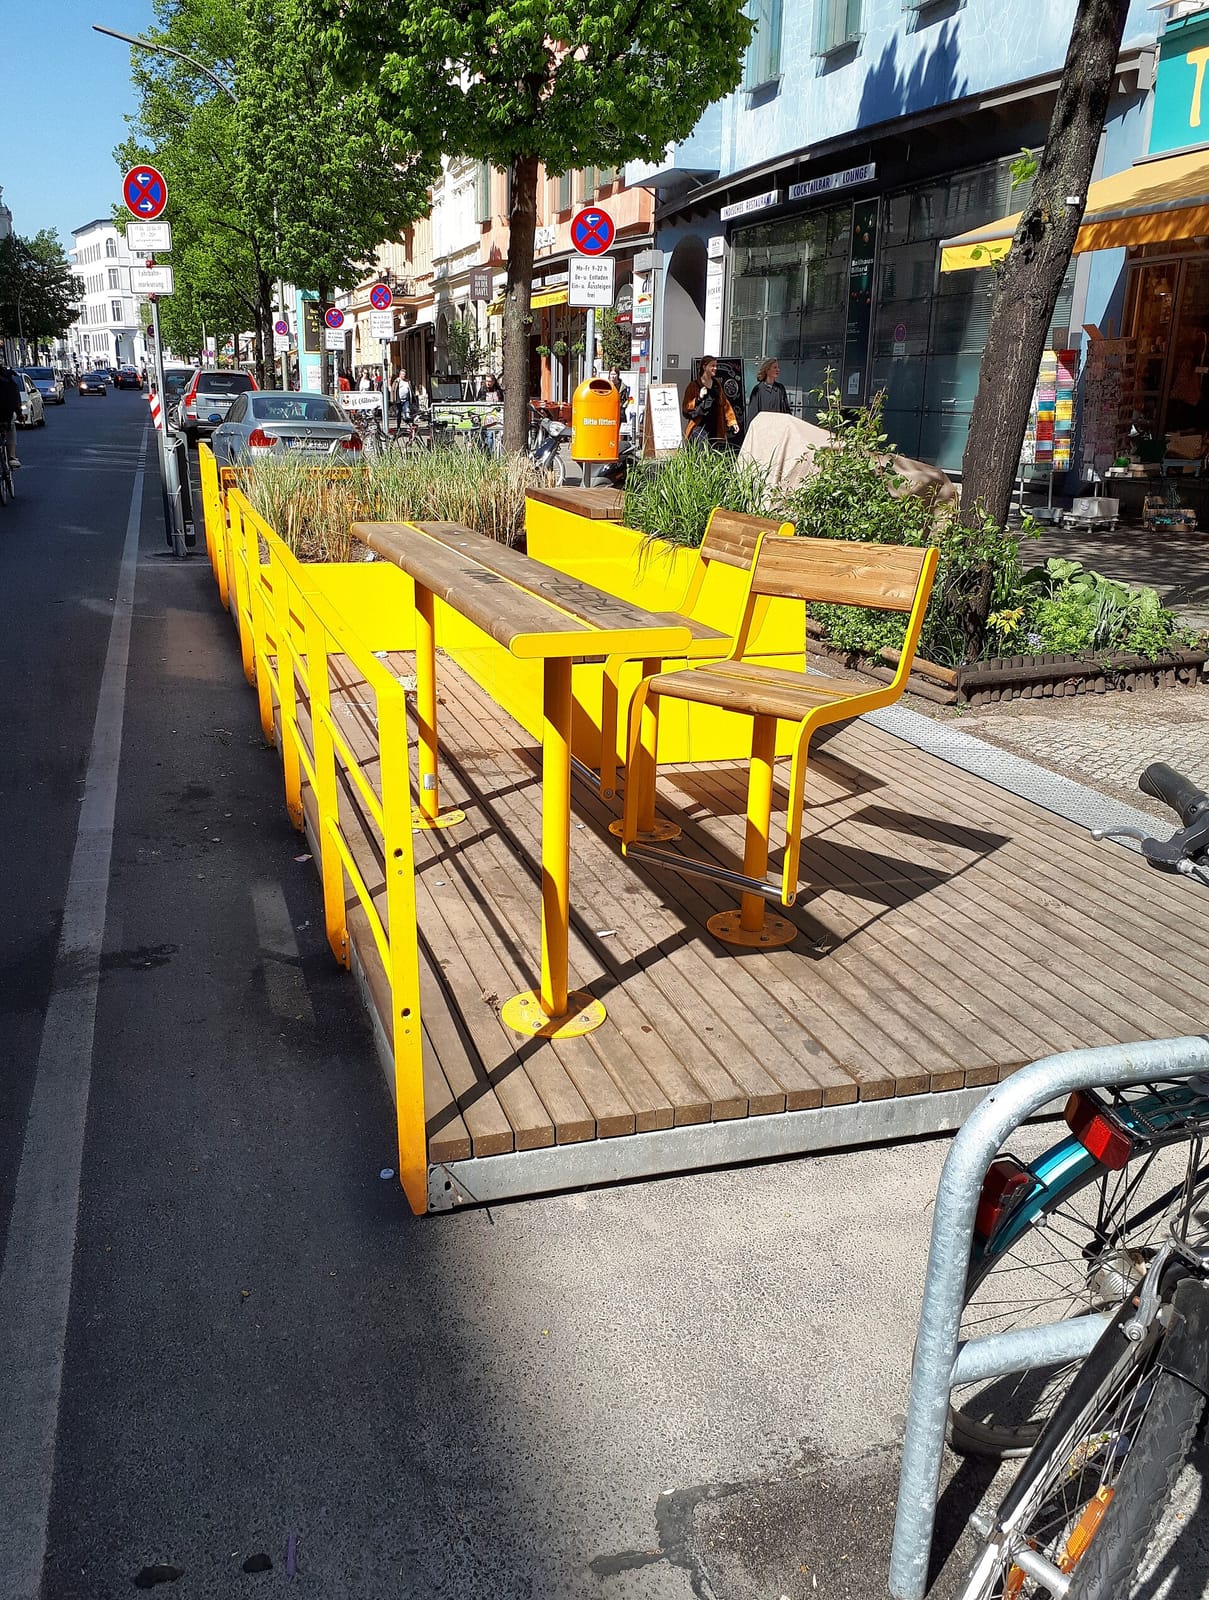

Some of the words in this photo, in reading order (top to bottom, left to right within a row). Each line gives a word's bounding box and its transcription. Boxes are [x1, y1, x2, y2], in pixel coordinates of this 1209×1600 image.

[793, 177, 830, 197] COCKTAILBAR
[842, 166, 868, 183] LOUNGE
[723, 204, 744, 218] INDISCHES
[746, 193, 772, 210] RESTAURANT
[583, 418, 598, 426] Bitte
